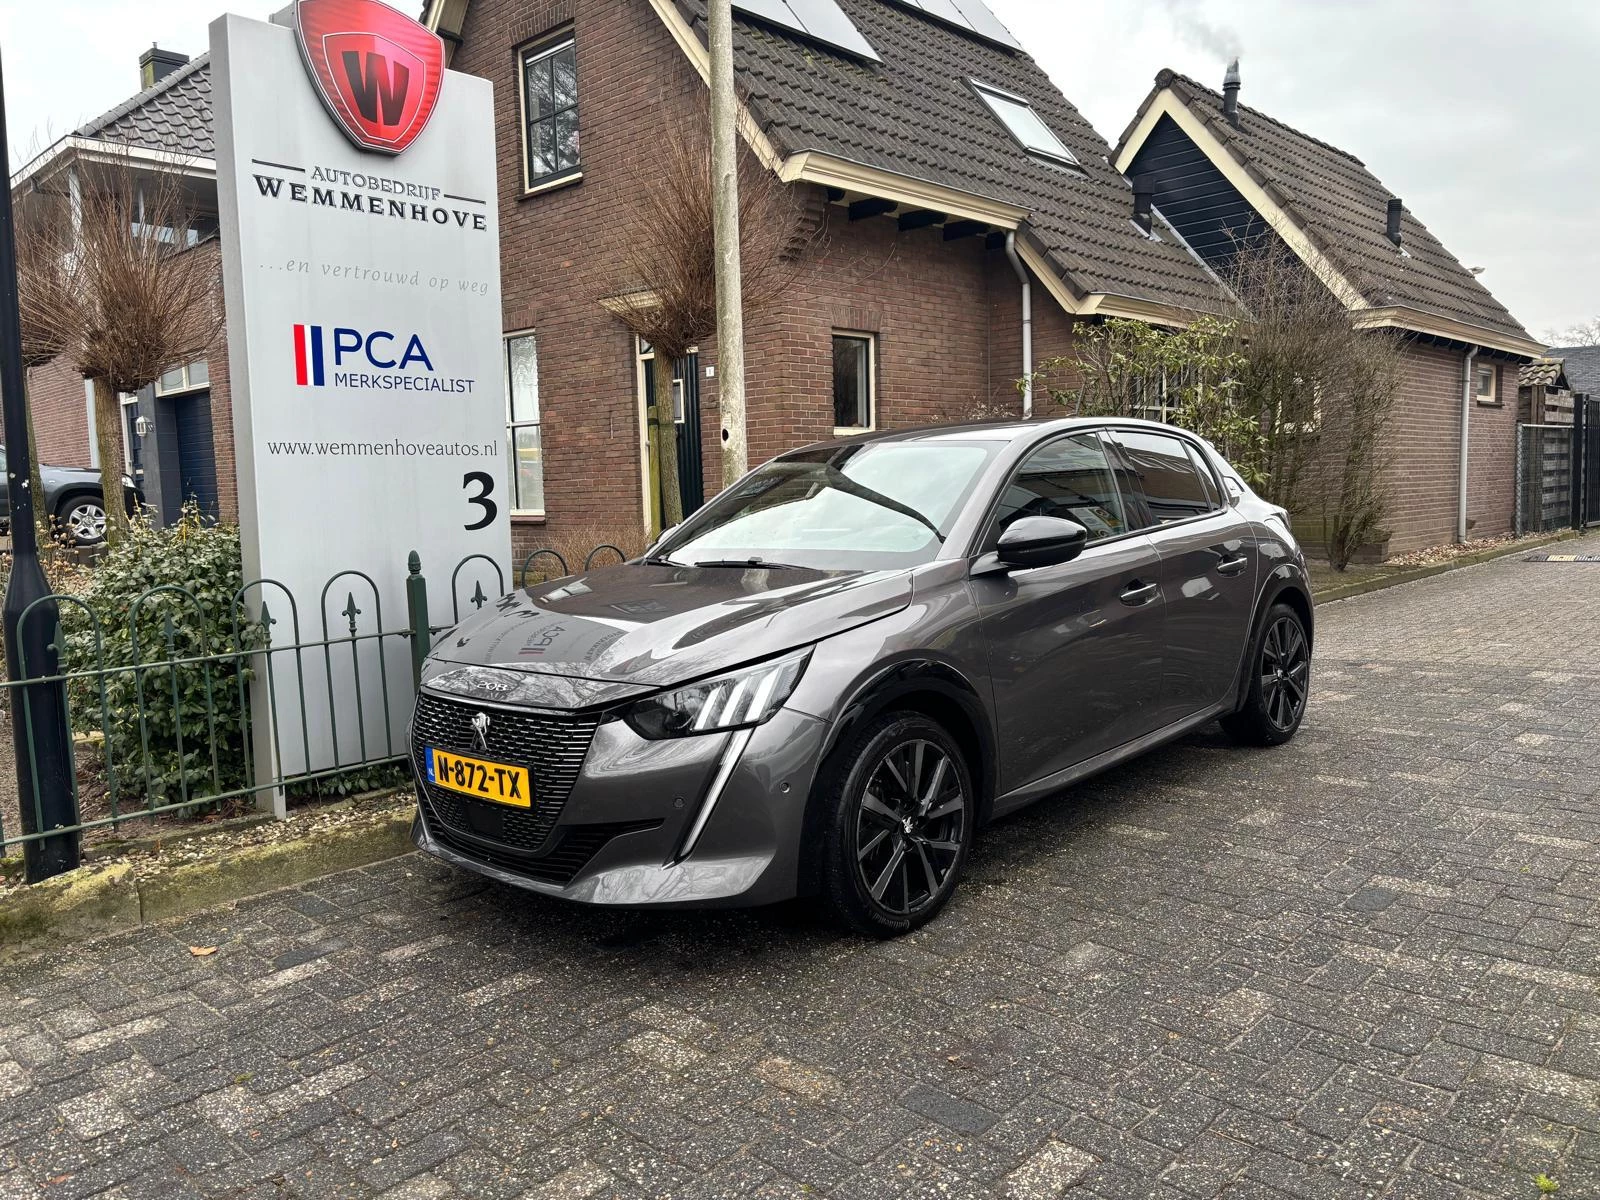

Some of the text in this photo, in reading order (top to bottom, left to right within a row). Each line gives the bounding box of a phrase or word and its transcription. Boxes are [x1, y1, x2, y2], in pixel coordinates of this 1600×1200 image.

[341, 50, 410, 127] W
[252, 173, 488, 232] WEMMENHOVE
[310, 165, 441, 201] AUTOBEDRIJF
[321, 262, 420, 286] vertrouwd
[428, 275, 449, 292] op
[458, 280, 489, 296] weg
[333, 327, 434, 372] PCA
[334, 372, 475, 393] MERKSPECIALIST
[267, 438, 498, 457] www.wemmenhoveautos.nl
[462, 471, 498, 531] 3
[437, 754, 522, 800] N-872-TX
